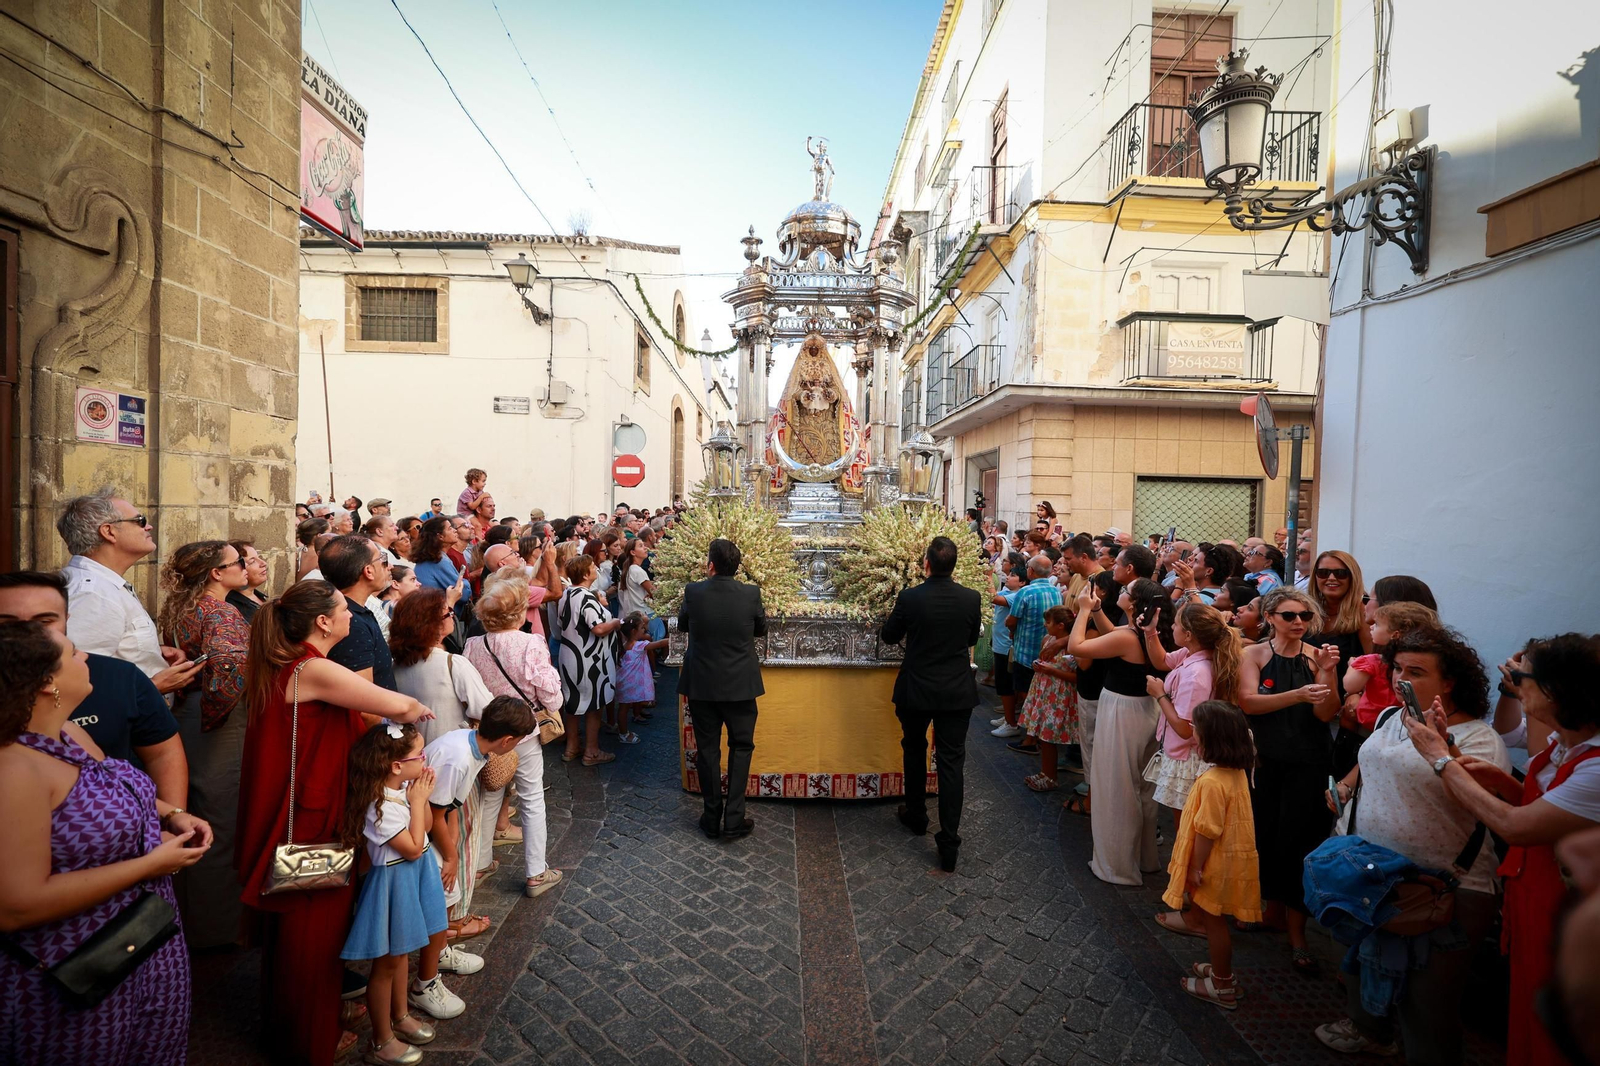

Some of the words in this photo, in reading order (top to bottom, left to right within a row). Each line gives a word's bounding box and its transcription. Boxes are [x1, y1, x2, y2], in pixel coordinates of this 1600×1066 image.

[301, 65, 320, 95] LA
[324, 88, 366, 138] DIANA
[303, 56, 368, 121] ALIMENTACION
[1168, 355, 1243, 370] 956482581
[1169, 338, 1195, 348] CASA
[1197, 339, 1210, 348] EN
[1212, 340, 1244, 349] VENTA
